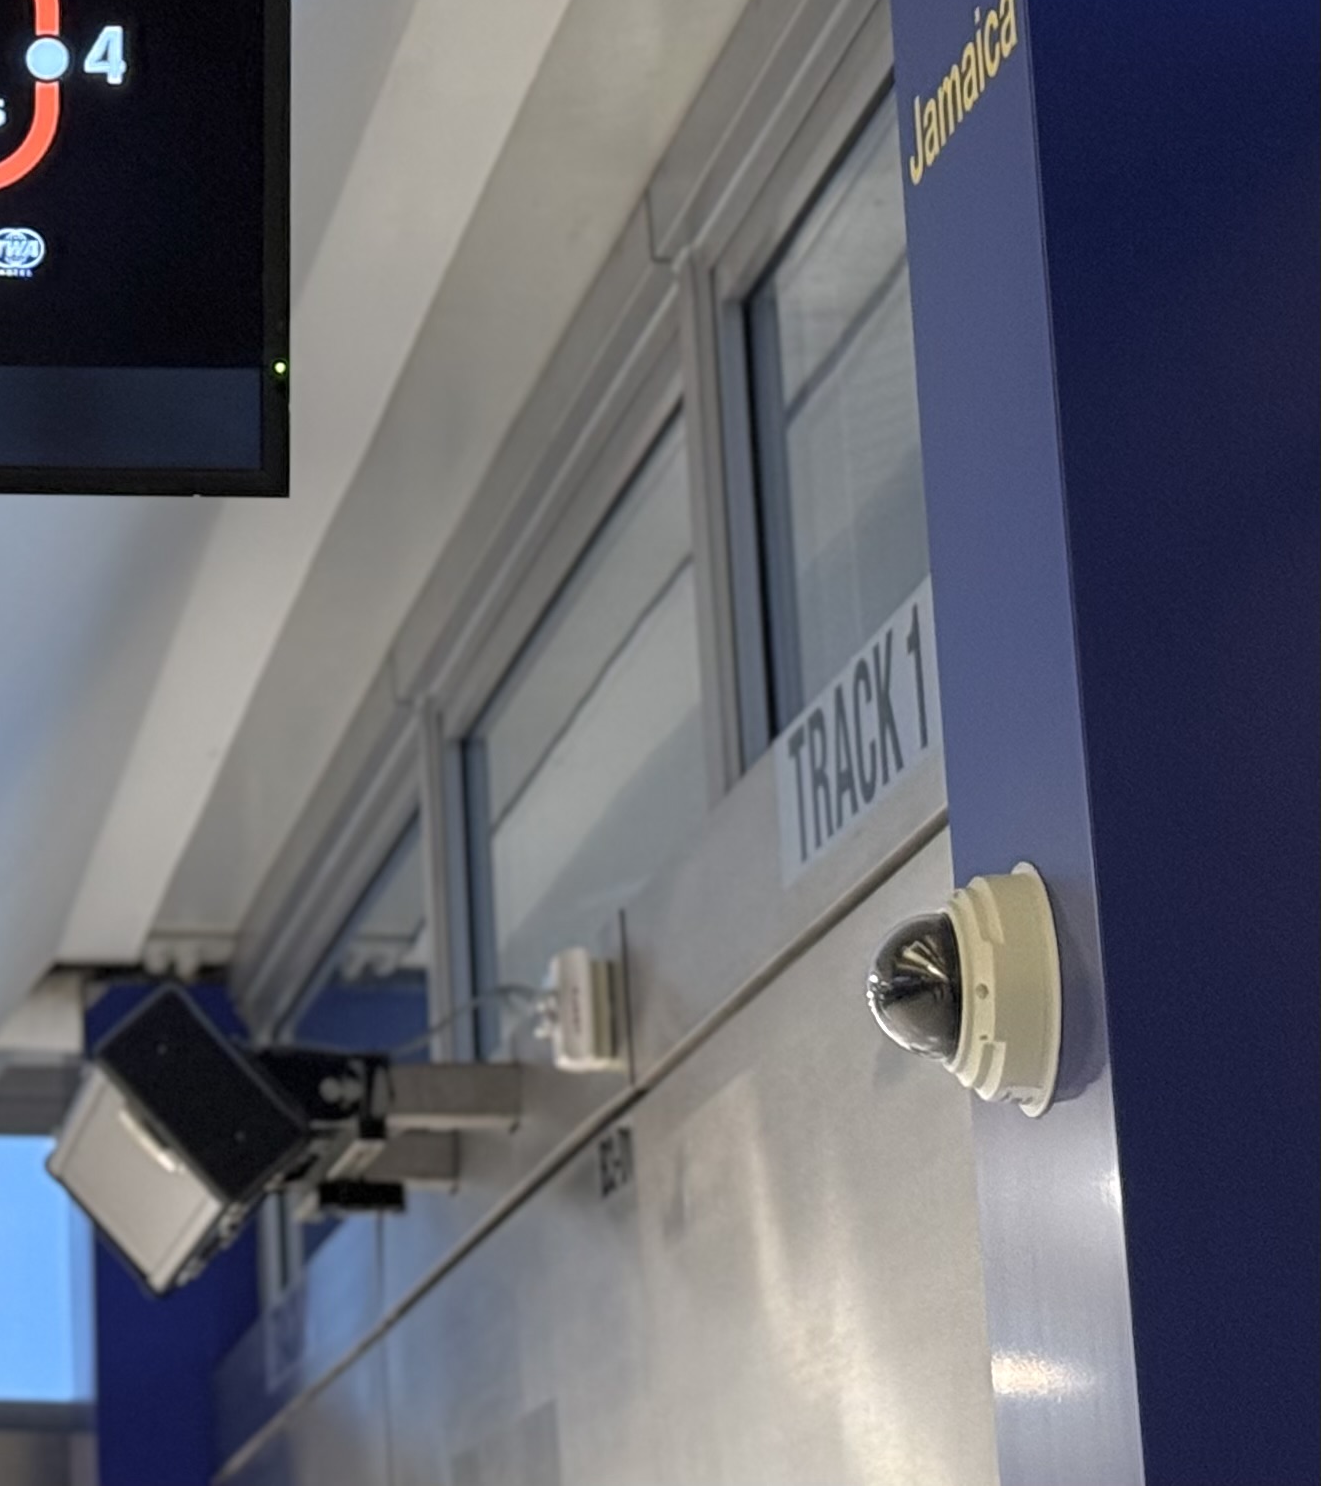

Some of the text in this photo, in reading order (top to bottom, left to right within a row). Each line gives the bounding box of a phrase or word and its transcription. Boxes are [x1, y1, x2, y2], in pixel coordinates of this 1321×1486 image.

[83, 25, 127, 85] 4
[788, 602, 929, 864] TRACK 1
